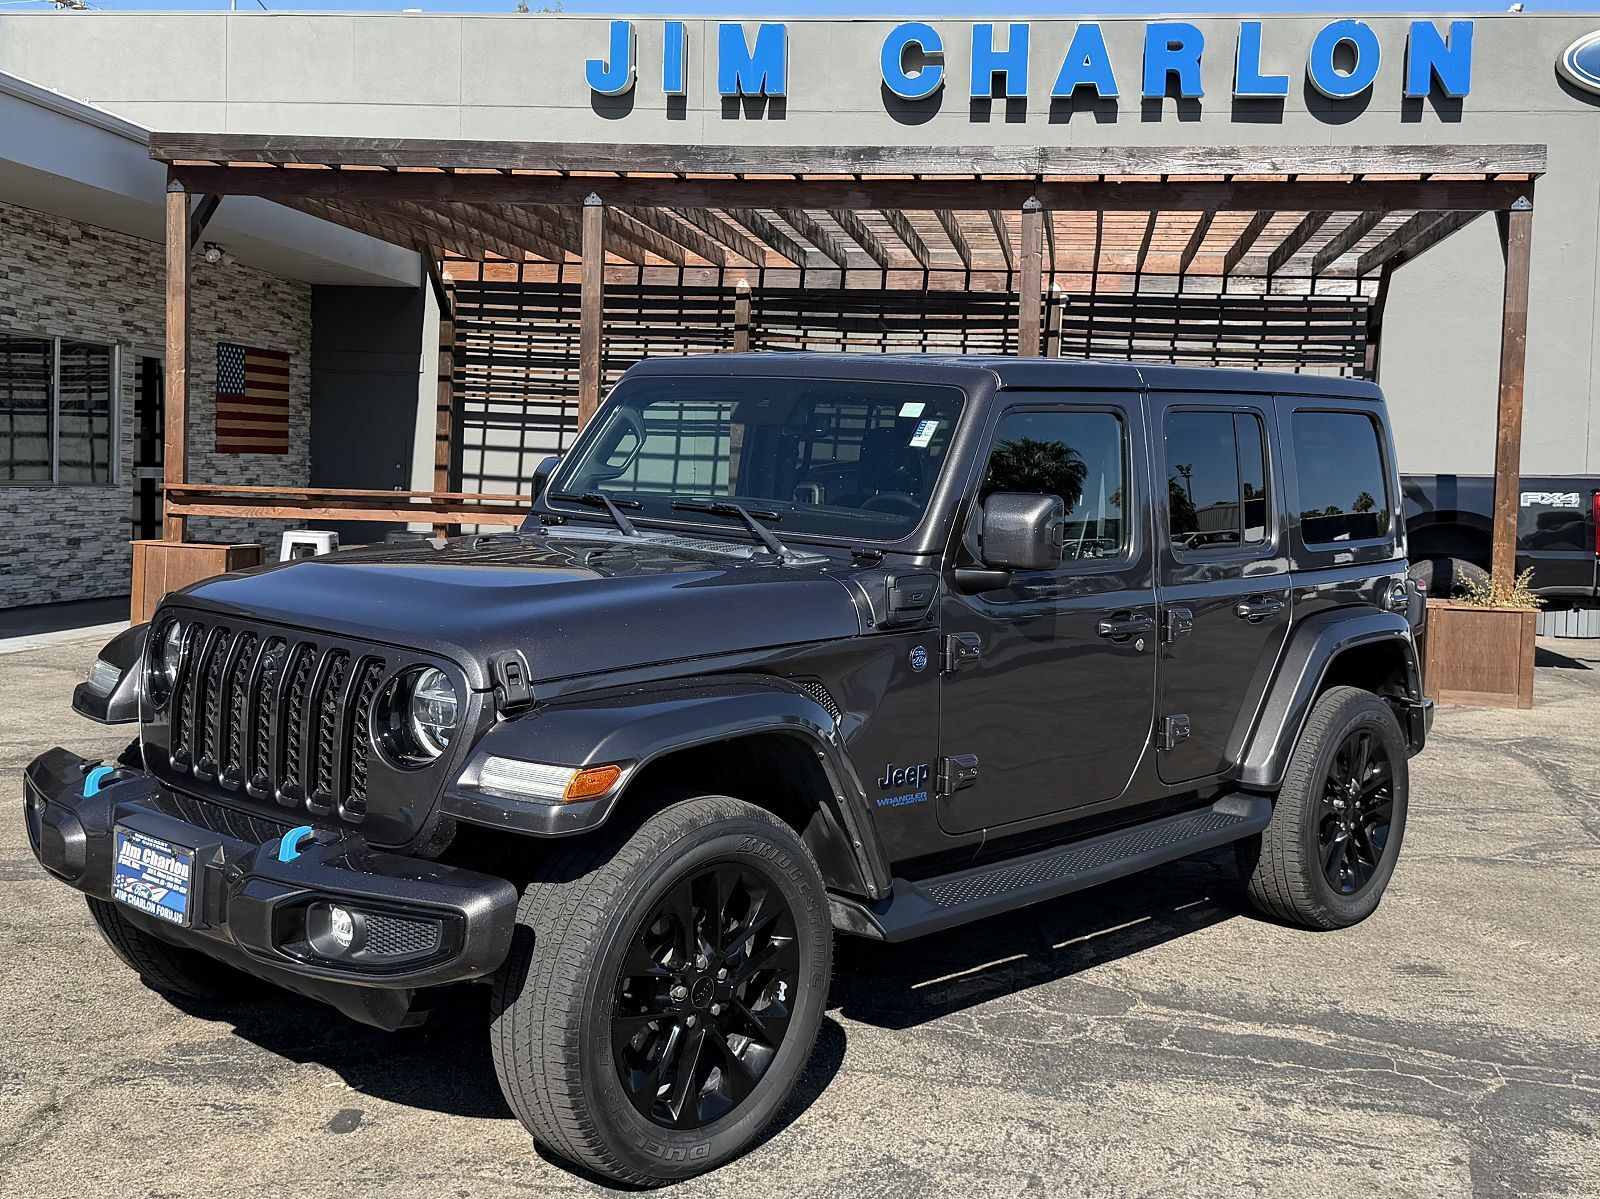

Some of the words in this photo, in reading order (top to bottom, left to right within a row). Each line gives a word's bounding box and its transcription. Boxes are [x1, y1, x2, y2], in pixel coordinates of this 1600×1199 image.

[585, 20, 788, 97] JIM
[880, 18, 1474, 100] CHARLON
[1520, 491, 1580, 507] FX4
[877, 763, 930, 790] Jeep
[876, 791, 929, 807] WRANGLER
[120, 840, 142, 860] Jim
[142, 848, 189, 878] Charlon
[114, 888, 127, 901] JIM
[127, 893, 156, 914] CHARLON
[156, 904, 183, 924] FORD.US
[133, 884, 150, 899] Ford
[735, 836, 827, 990] BRIDGESTONE
